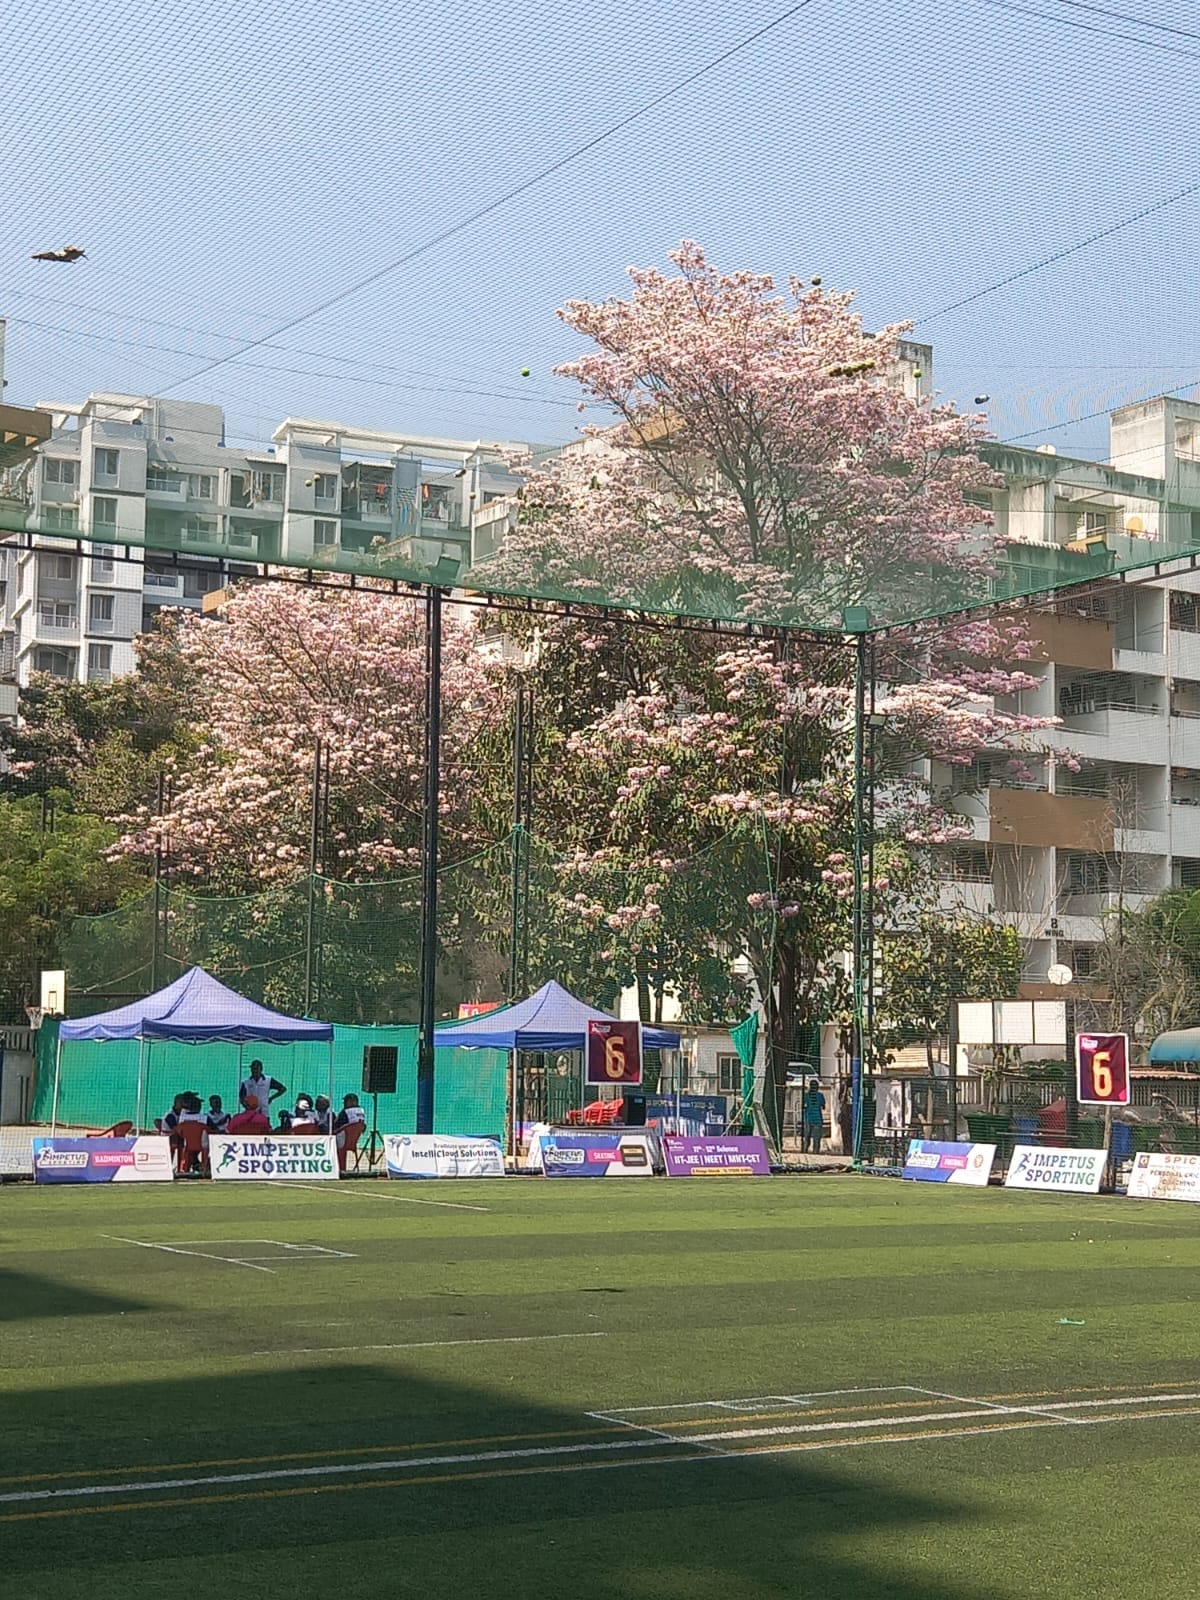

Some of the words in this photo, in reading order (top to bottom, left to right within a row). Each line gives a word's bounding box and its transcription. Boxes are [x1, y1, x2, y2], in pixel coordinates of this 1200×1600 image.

[606, 1036, 625, 1078] 6
[1093, 1051, 1112, 1097] 6
[50, 1153, 87, 1161] IMPETUS
[242, 1143, 326, 1157] IMPETUS
[412, 1150, 459, 1158] IntelliCloud
[461, 1150, 498, 1158] Solutions
[94, 1154, 134, 1164] BADMINTON
[704, 1154, 723, 1164] NEET
[1033, 1154, 1095, 1170] IMPETUS
[238, 1160, 333, 1174] SPORTING
[1025, 1169, 1095, 1186] SPORTING
